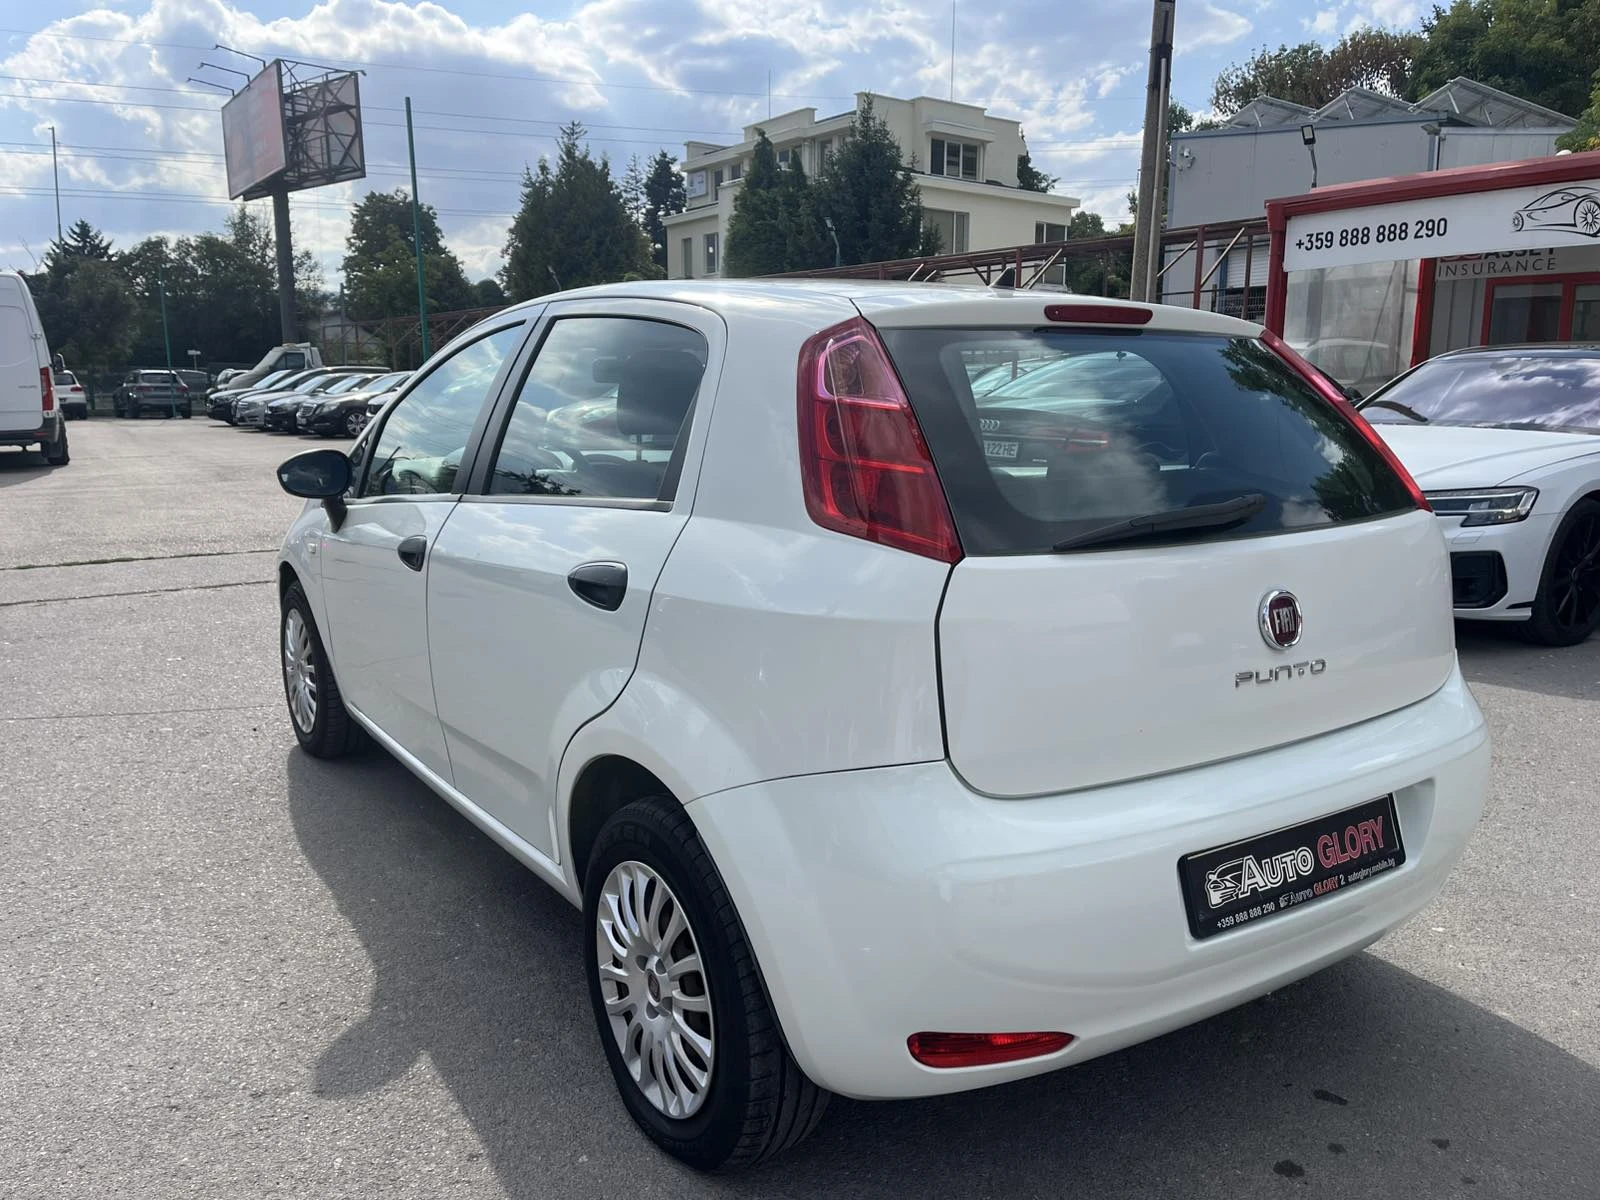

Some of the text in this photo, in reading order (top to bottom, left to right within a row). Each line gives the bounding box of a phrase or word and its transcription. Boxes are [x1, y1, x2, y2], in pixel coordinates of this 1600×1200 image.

[1296, 217, 1448, 251] +359 888 888 290
[1438, 257, 1557, 278] INSURANCE
[1273, 607, 1295, 634] FIAT
[1235, 659, 1326, 688] PUNTO
[1317, 816, 1384, 868] GLORY
[1217, 915, 1234, 929] +359
[1235, 911, 1249, 924] 888
[1249, 906, 1262, 919] 888
[1262, 901, 1276, 915] 290
[1313, 875, 1339, 896] GLORY
[1339, 874, 1346, 885] 2
